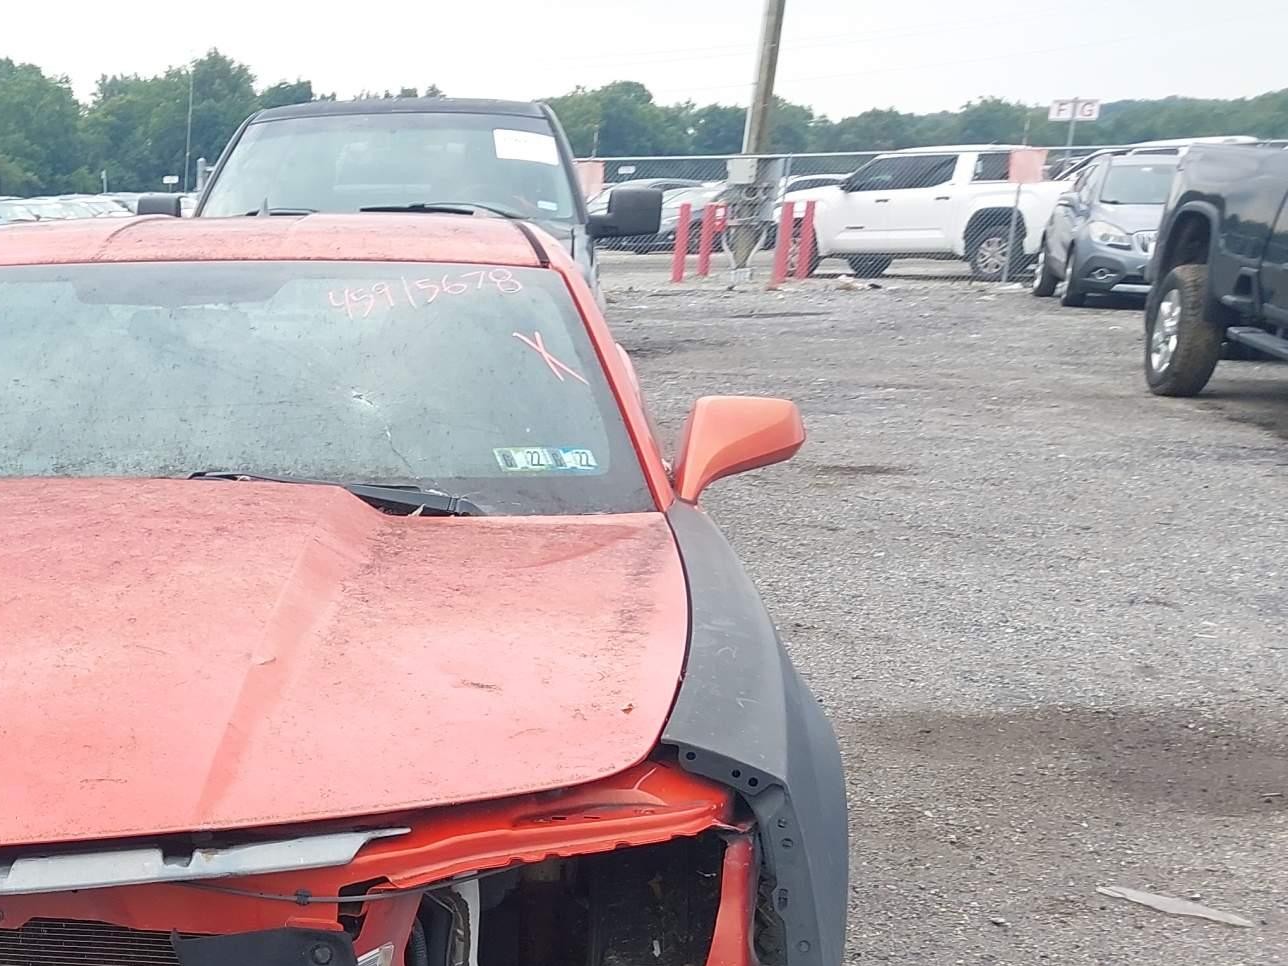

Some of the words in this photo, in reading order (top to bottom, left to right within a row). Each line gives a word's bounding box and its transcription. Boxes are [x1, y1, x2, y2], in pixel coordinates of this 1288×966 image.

[1057, 102, 1069, 117] F
[1080, 102, 1094, 117] G
[328, 268, 523, 320] 45915678
[526, 450, 545, 467] 22
[575, 451, 595, 467] 22
